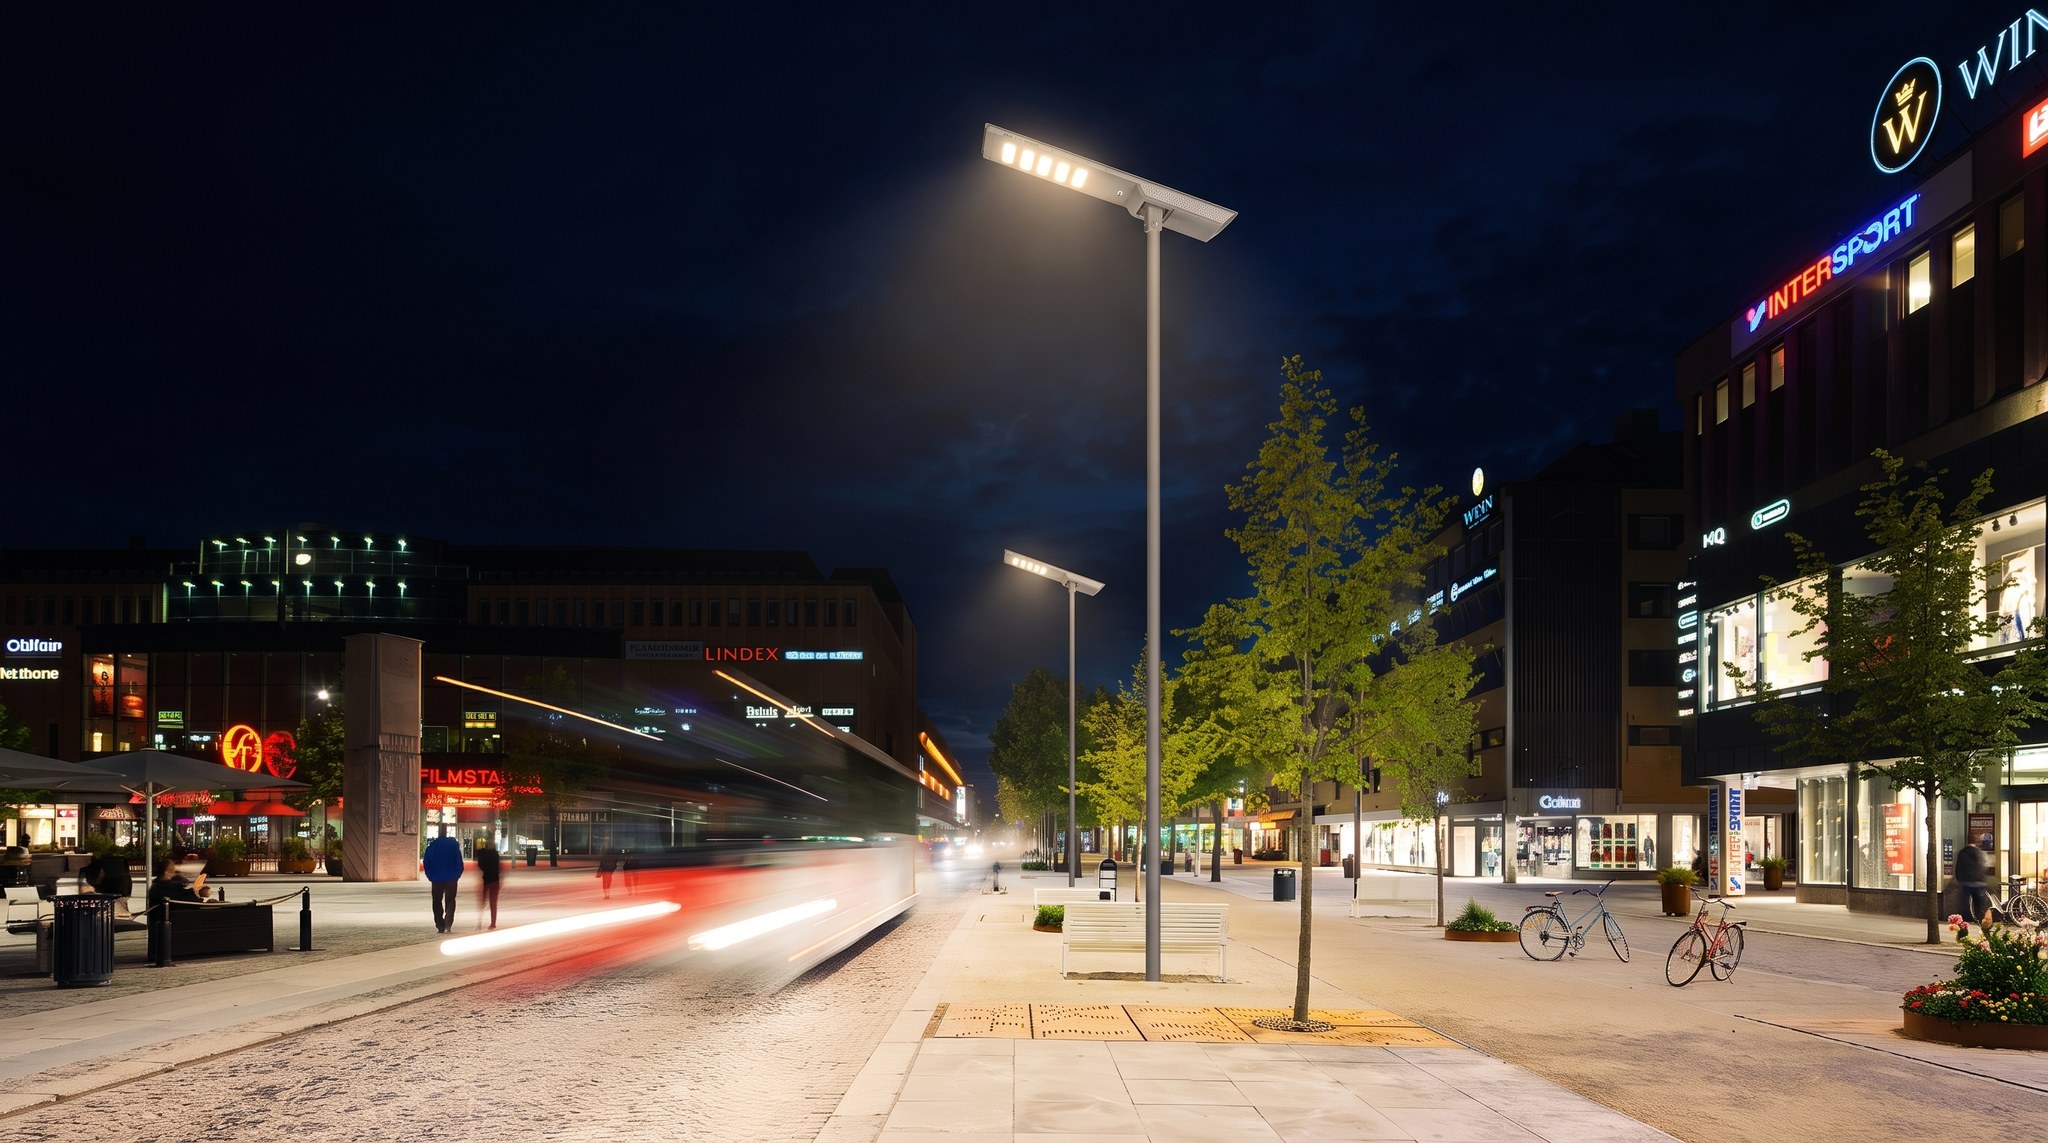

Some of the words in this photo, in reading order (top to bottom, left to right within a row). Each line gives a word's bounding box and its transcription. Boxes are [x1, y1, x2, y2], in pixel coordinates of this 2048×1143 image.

[1882, 90, 1927, 154] W
[1767, 193, 1919, 319] INTERSPORT
[705, 647, 779, 661] LINDEX
[420, 768, 541, 785] FILMSTA
